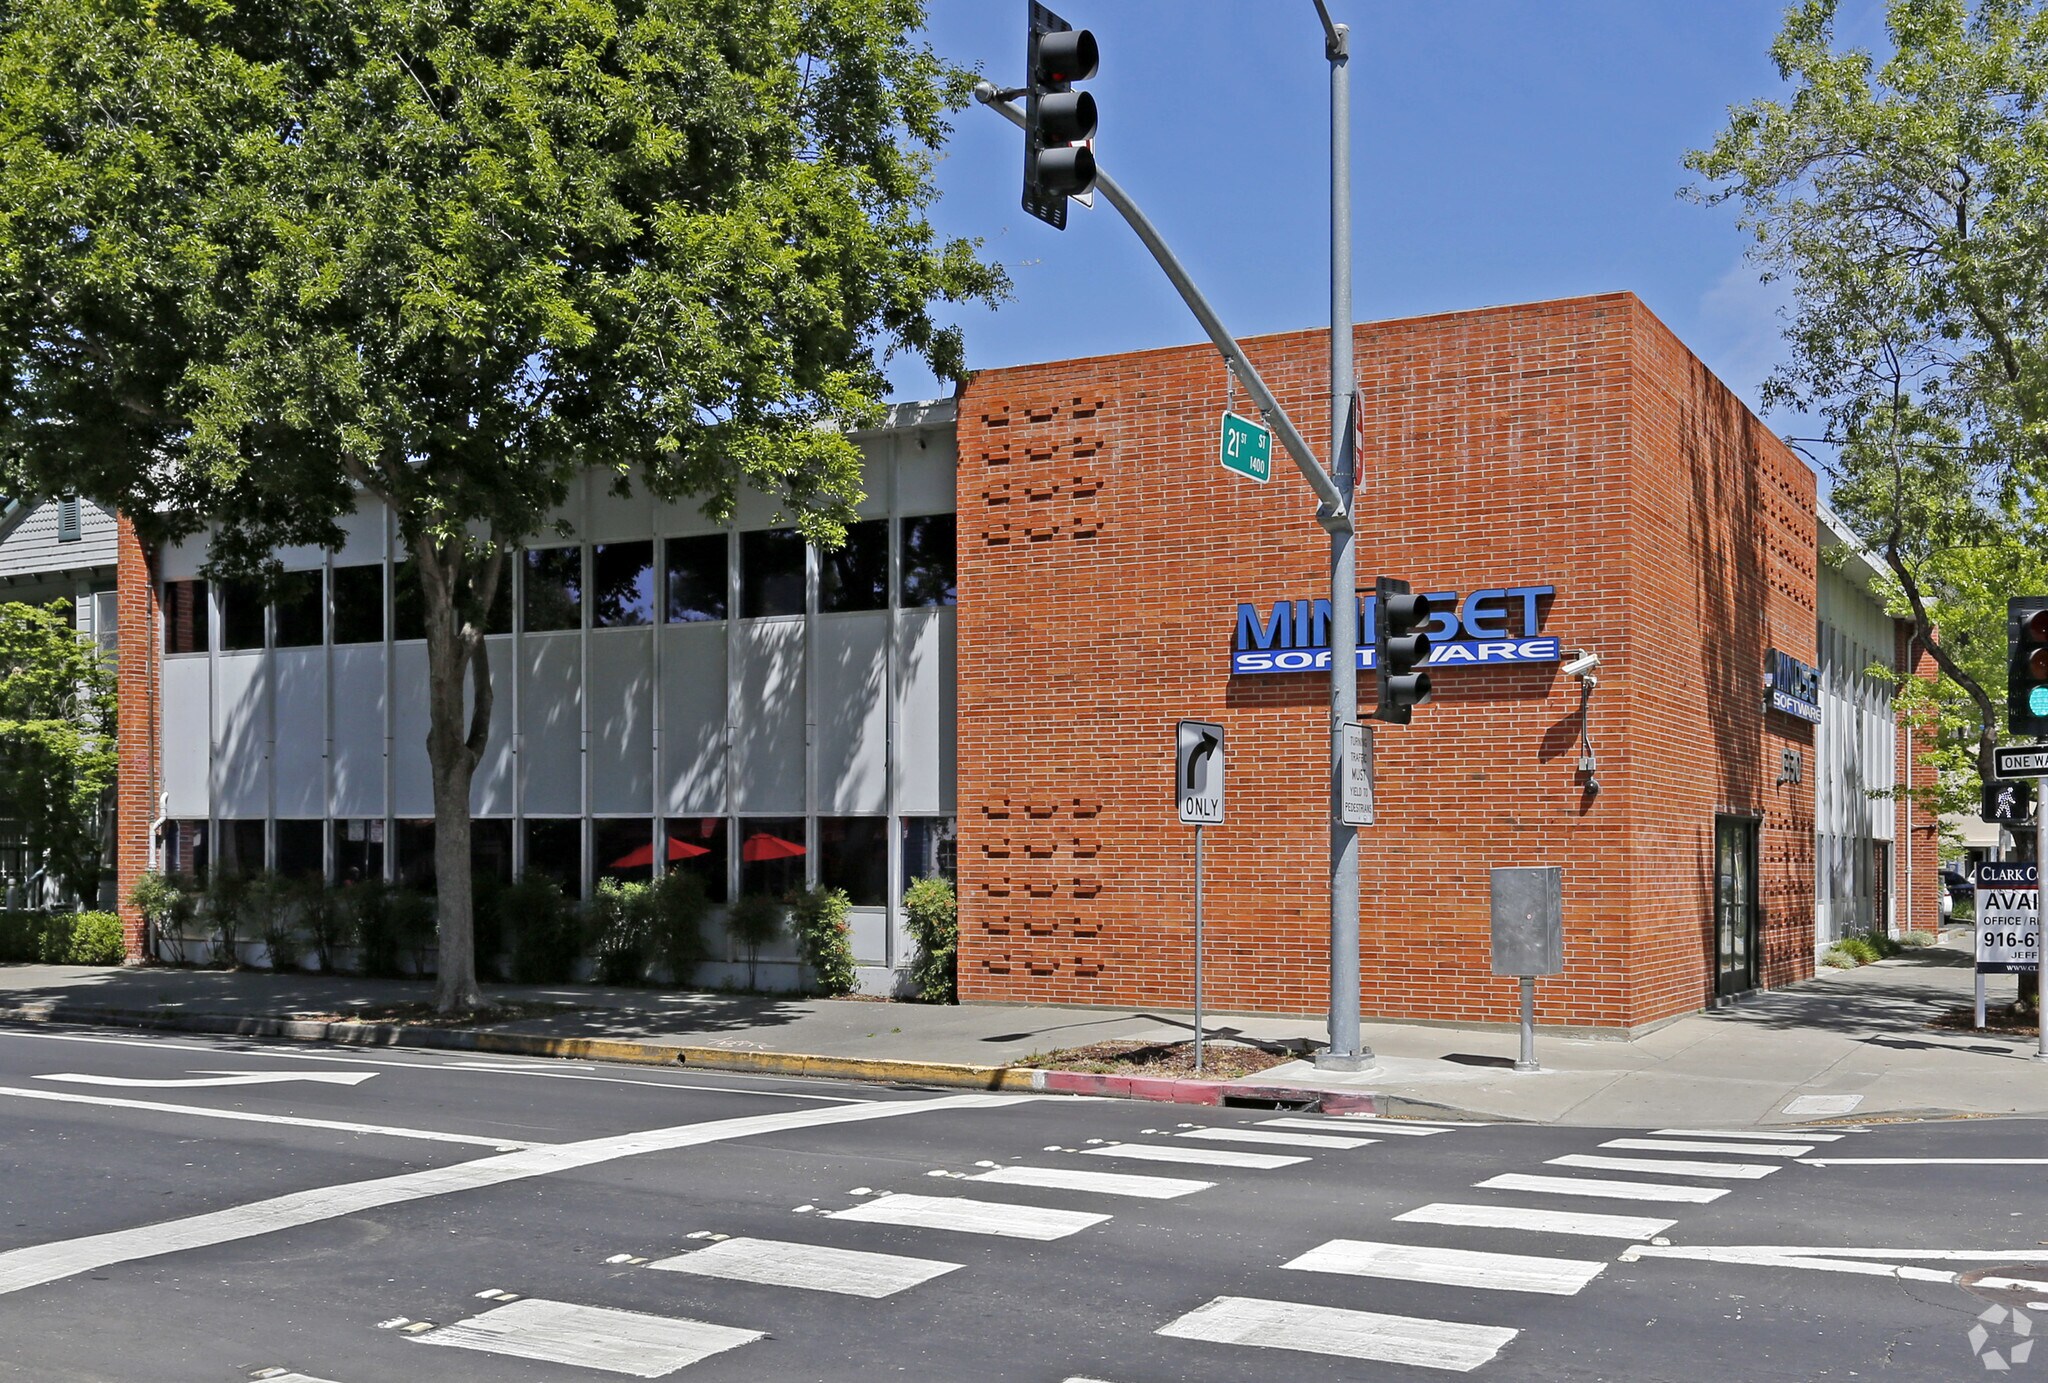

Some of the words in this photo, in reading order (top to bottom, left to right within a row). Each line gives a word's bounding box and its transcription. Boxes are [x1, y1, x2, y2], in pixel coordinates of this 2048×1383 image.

[1258, 434, 1266, 450] ST
[1250, 456, 1265, 474] 1400
[1237, 585, 1555, 650] MINSET
[1236, 640, 1555, 671] SOFTARE
[1773, 692, 1821, 721] SOFTWARE
[1350, 736, 1368, 748] TURNING
[1350, 752, 1367, 764] TRAFFIC
[2005, 756, 2031, 768] ONE
[1351, 768, 1366, 781] MUST
[1350, 786, 1362, 797] YIELD
[1363, 787, 1369, 798] TO
[1186, 797, 1218, 816] ONLY
[1345, 802, 1372, 814] PEDESTRIANS
[2026, 866, 2039, 881] C
[1983, 916, 2021, 926] OFFICE
[2011, 951, 2038, 959] JEFF
